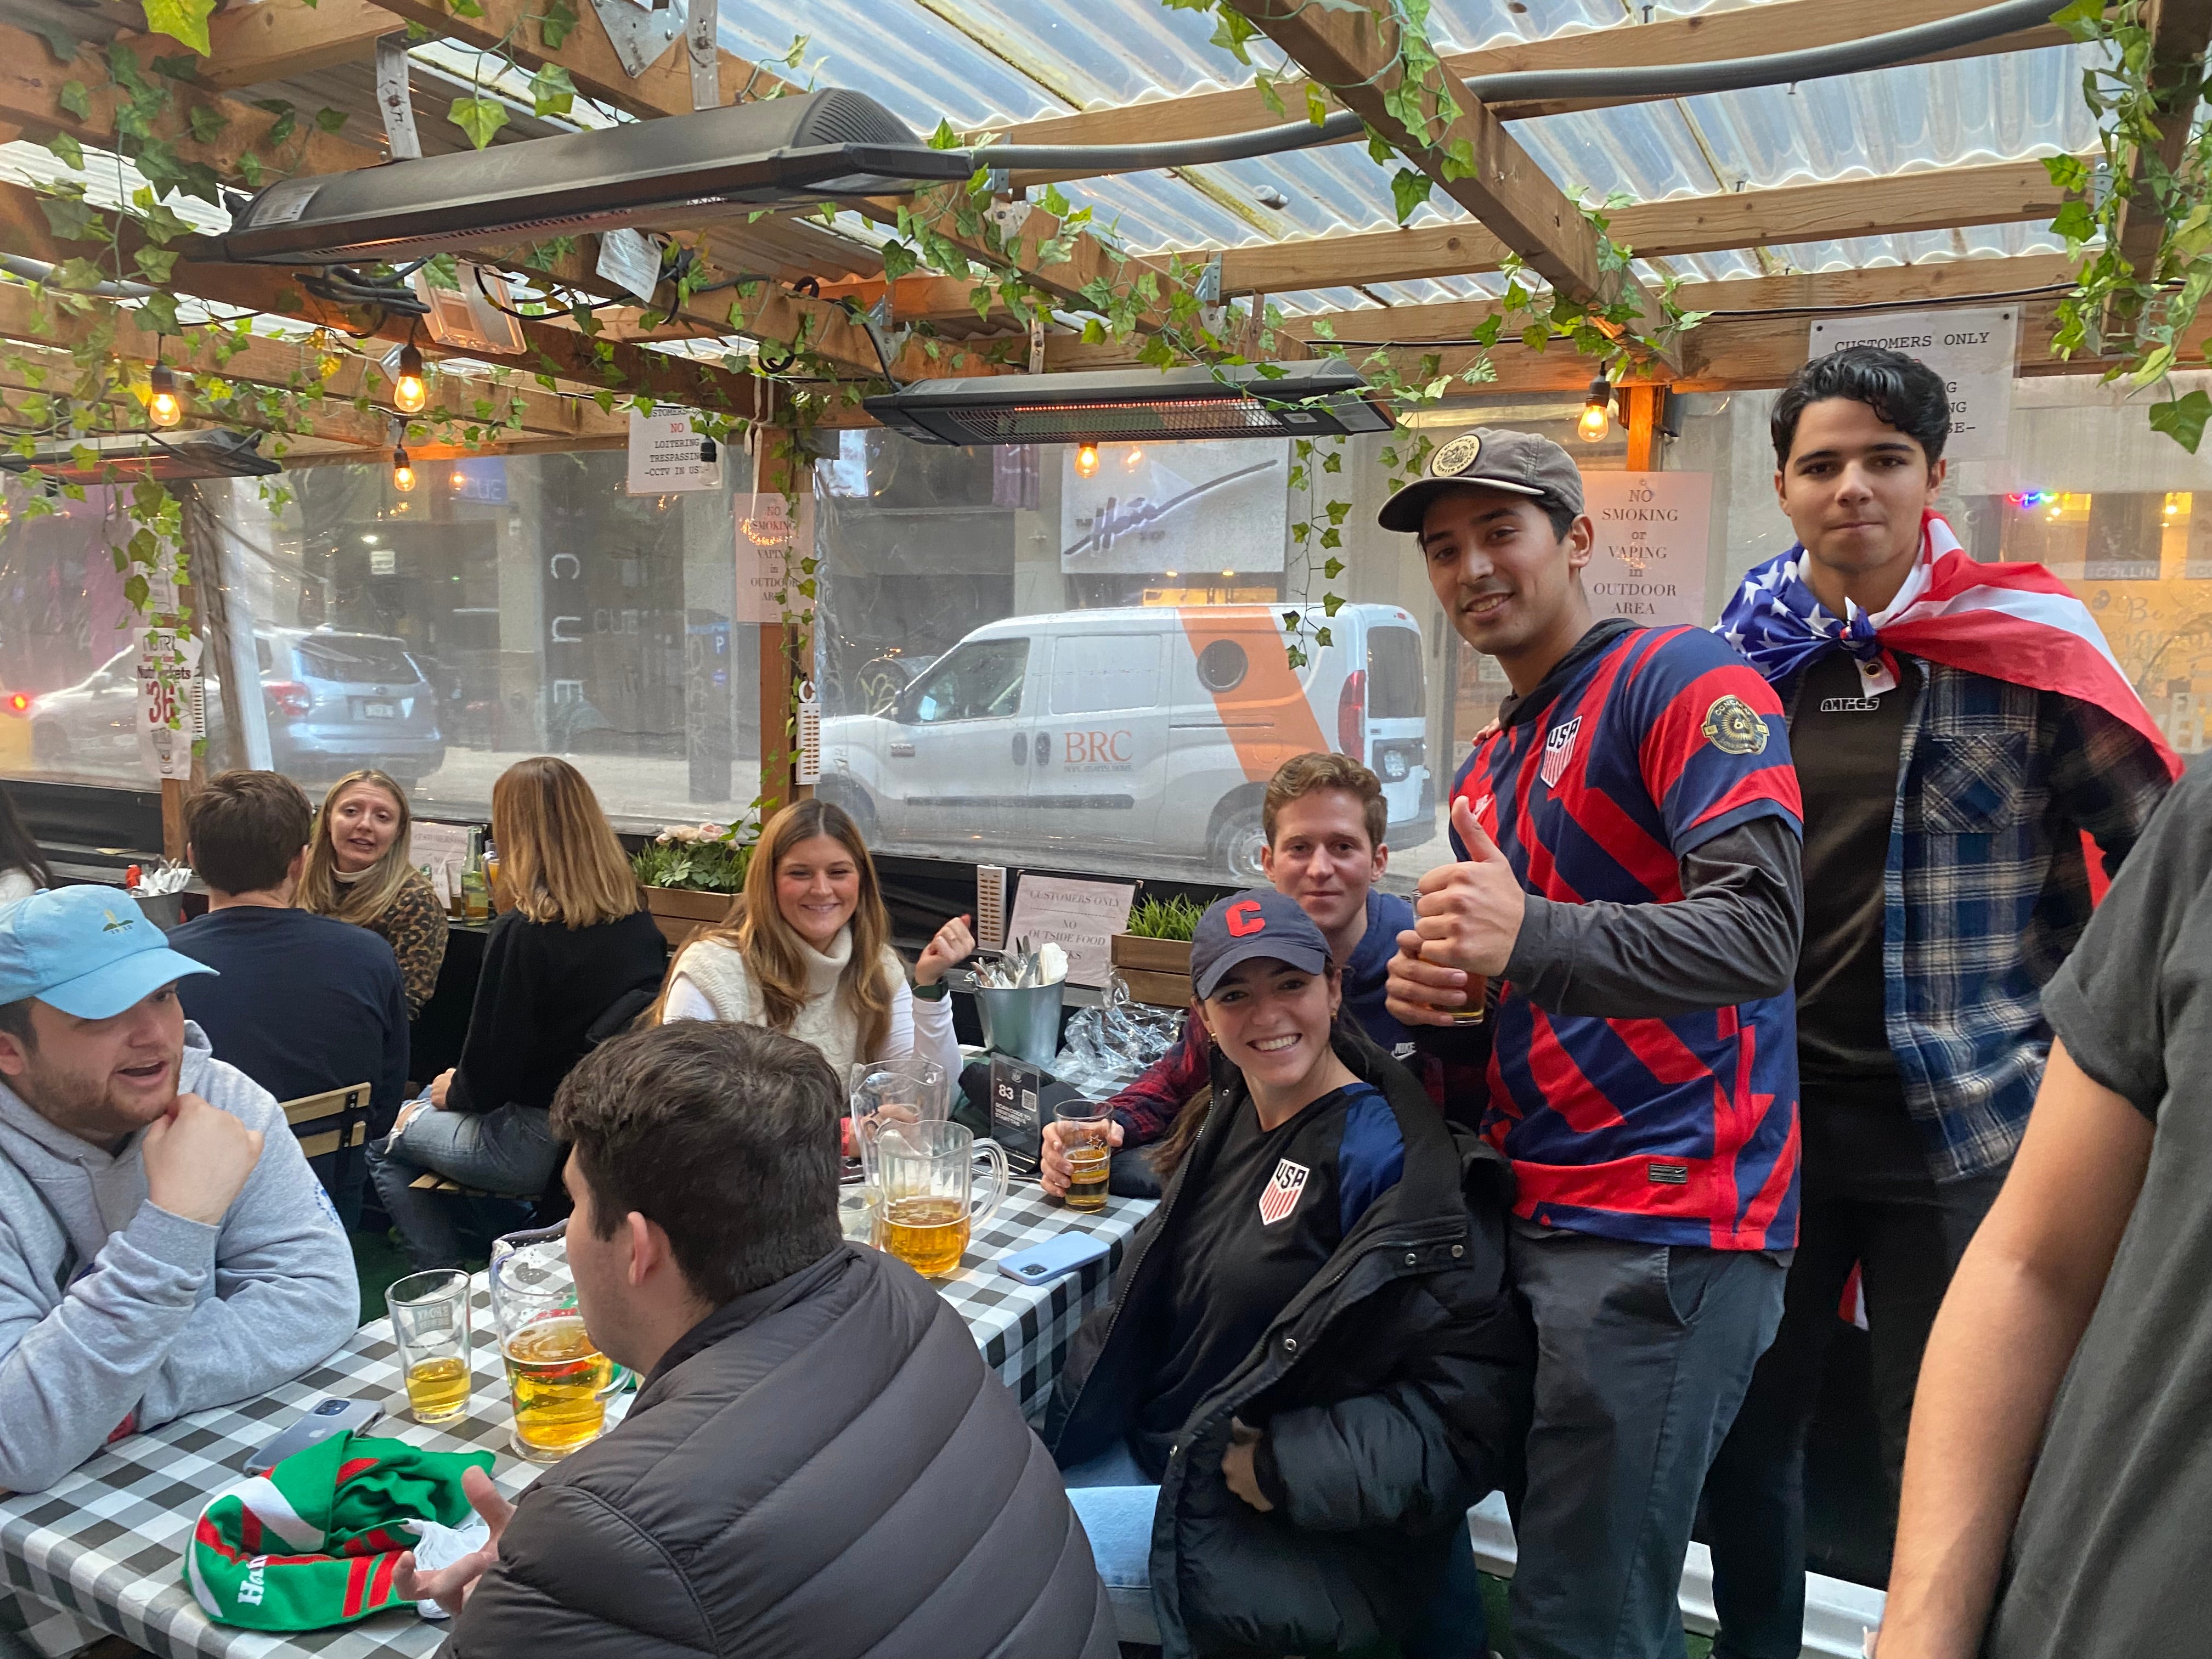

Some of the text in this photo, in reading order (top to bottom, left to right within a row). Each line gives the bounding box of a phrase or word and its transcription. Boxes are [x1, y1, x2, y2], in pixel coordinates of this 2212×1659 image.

[1944, 332, 1990, 345] ONLY
[670, 423, 685, 433] NO
[654, 438, 700, 449] LOITERING
[650, 452, 701, 462] TRESPASSIN
[1628, 489, 1652, 502] NO
[767, 506, 781, 516] NO
[1601, 509, 1679, 522] SMOKING
[1631, 531, 1647, 540] or
[757, 549, 785, 559] VAPIN
[1608, 546, 1667, 559] VAPING
[770, 564, 779, 573] in
[1628, 565, 1644, 577] in
[1593, 583, 1677, 597] OUTDOOR
[1611, 602, 1655, 615] AREA
[550, 552, 583, 704] CUE
[1548, 718, 1579, 749] USA
[1064, 730, 1133, 763] BRC
[1030, 890, 1120, 907] CUSTOMERS ONLY
[1063, 919, 1077, 929] NO
[1225, 900, 1266, 938] C
[1029, 929, 1106, 946] OUTSIDE FOOD
[998, 1084, 1014, 1101] 83
[1276, 1162, 1307, 1189] USA
